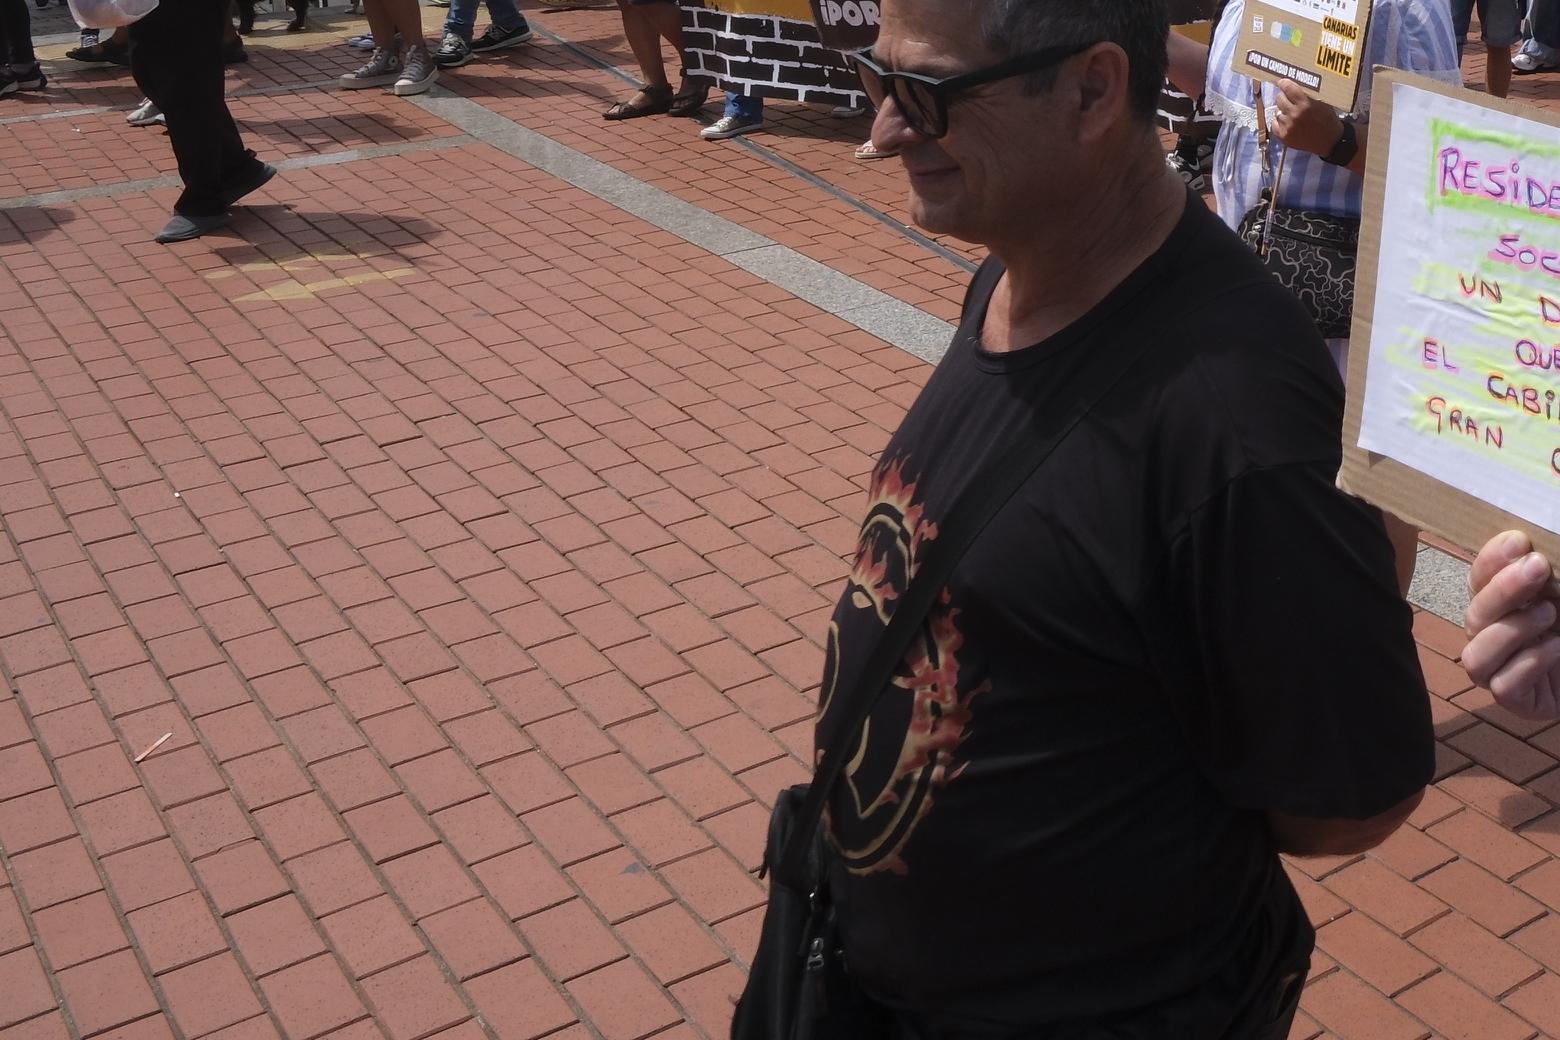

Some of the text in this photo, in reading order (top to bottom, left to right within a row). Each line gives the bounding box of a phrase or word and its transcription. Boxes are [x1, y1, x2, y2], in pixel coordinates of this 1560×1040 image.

[1323, 16, 1357, 40] CANARIAS
[1320, 31, 1355, 56] TIENE UN
[1261, 56, 1270, 68] UN
[1268, 60, 1289, 76] CAMBIO
[1288, 66, 1297, 79] DE
[1295, 70, 1319, 87] MODELO!
[1316, 44, 1352, 76] LÍMITE
[1459, 273, 1502, 303] UN
[1423, 341, 1457, 369] EL
[1428, 397, 1504, 448] GRAN
